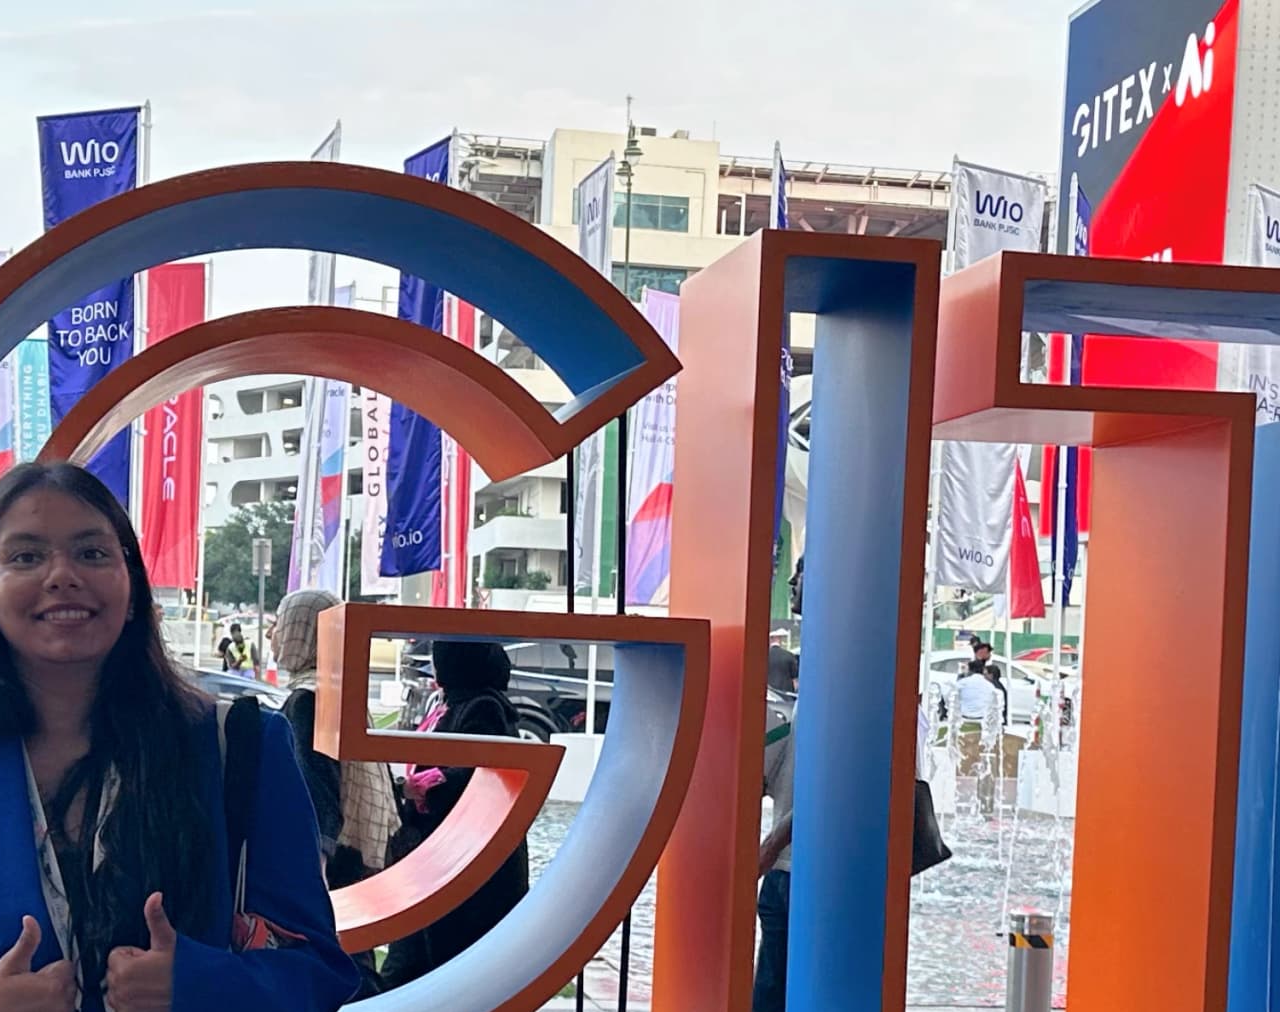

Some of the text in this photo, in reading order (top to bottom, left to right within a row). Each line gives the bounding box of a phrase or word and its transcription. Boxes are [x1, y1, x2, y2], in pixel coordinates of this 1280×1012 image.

[1072, 61, 1158, 158] GITEX
[65, 168, 92, 180] BANK
[973, 218, 997, 231] BANK
[72, 301, 118, 326] BORN
[56, 321, 129, 348] TO BACK
[76, 346, 112, 368] YOU
[327, 387, 346, 398] racle
[23, 364, 33, 455] VERYTHING
[162, 396, 178, 502] ACLE
[367, 392, 381, 497] GLOBAL
[958, 546, 995, 568] wio.o
